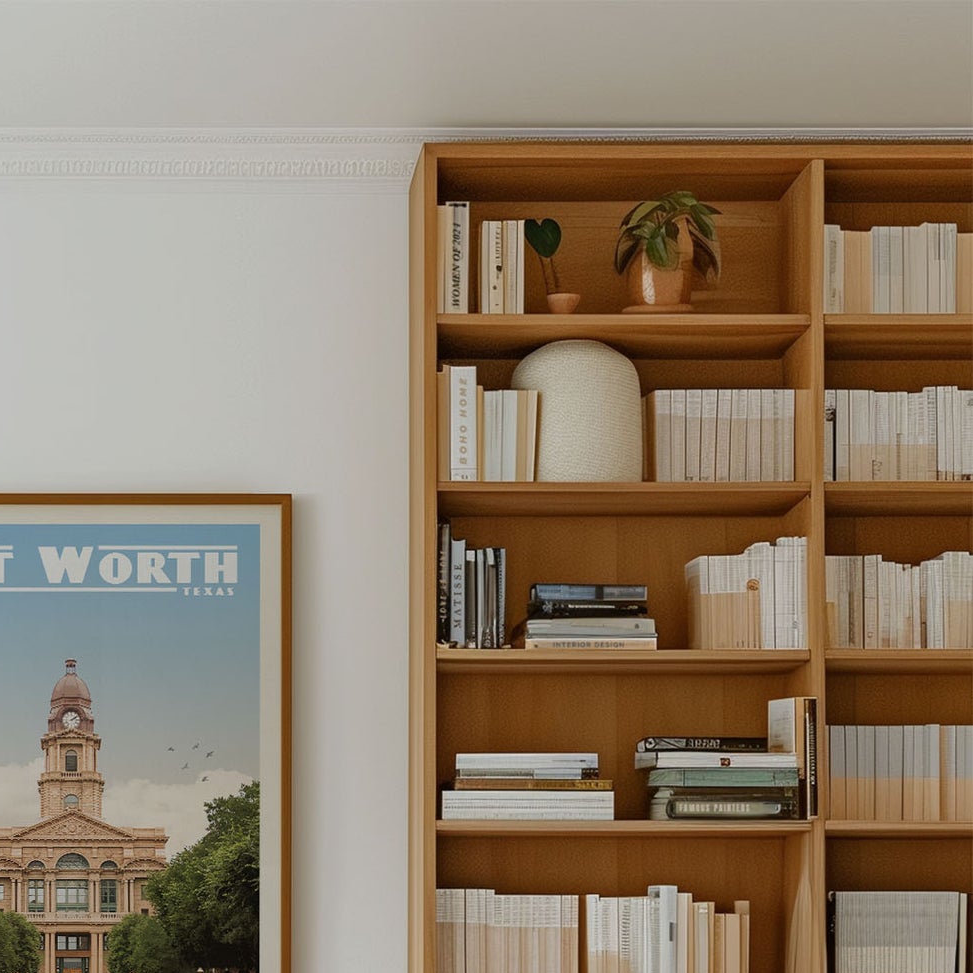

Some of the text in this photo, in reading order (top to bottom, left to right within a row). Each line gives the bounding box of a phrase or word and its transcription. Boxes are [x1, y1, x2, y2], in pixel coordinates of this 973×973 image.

[451, 247, 461, 262] OF
[451, 264, 461, 307] WOMEN
[459, 377, 468, 465] BOHO HOME
[38, 545, 238, 584] WORTH
[182, 587, 235, 596] TEXAS
[453, 563, 462, 629] MATISSE
[552, 641, 625, 649] INTERIOR DESIGN
[679, 803, 750, 813] FAMOUS PAINTERS
